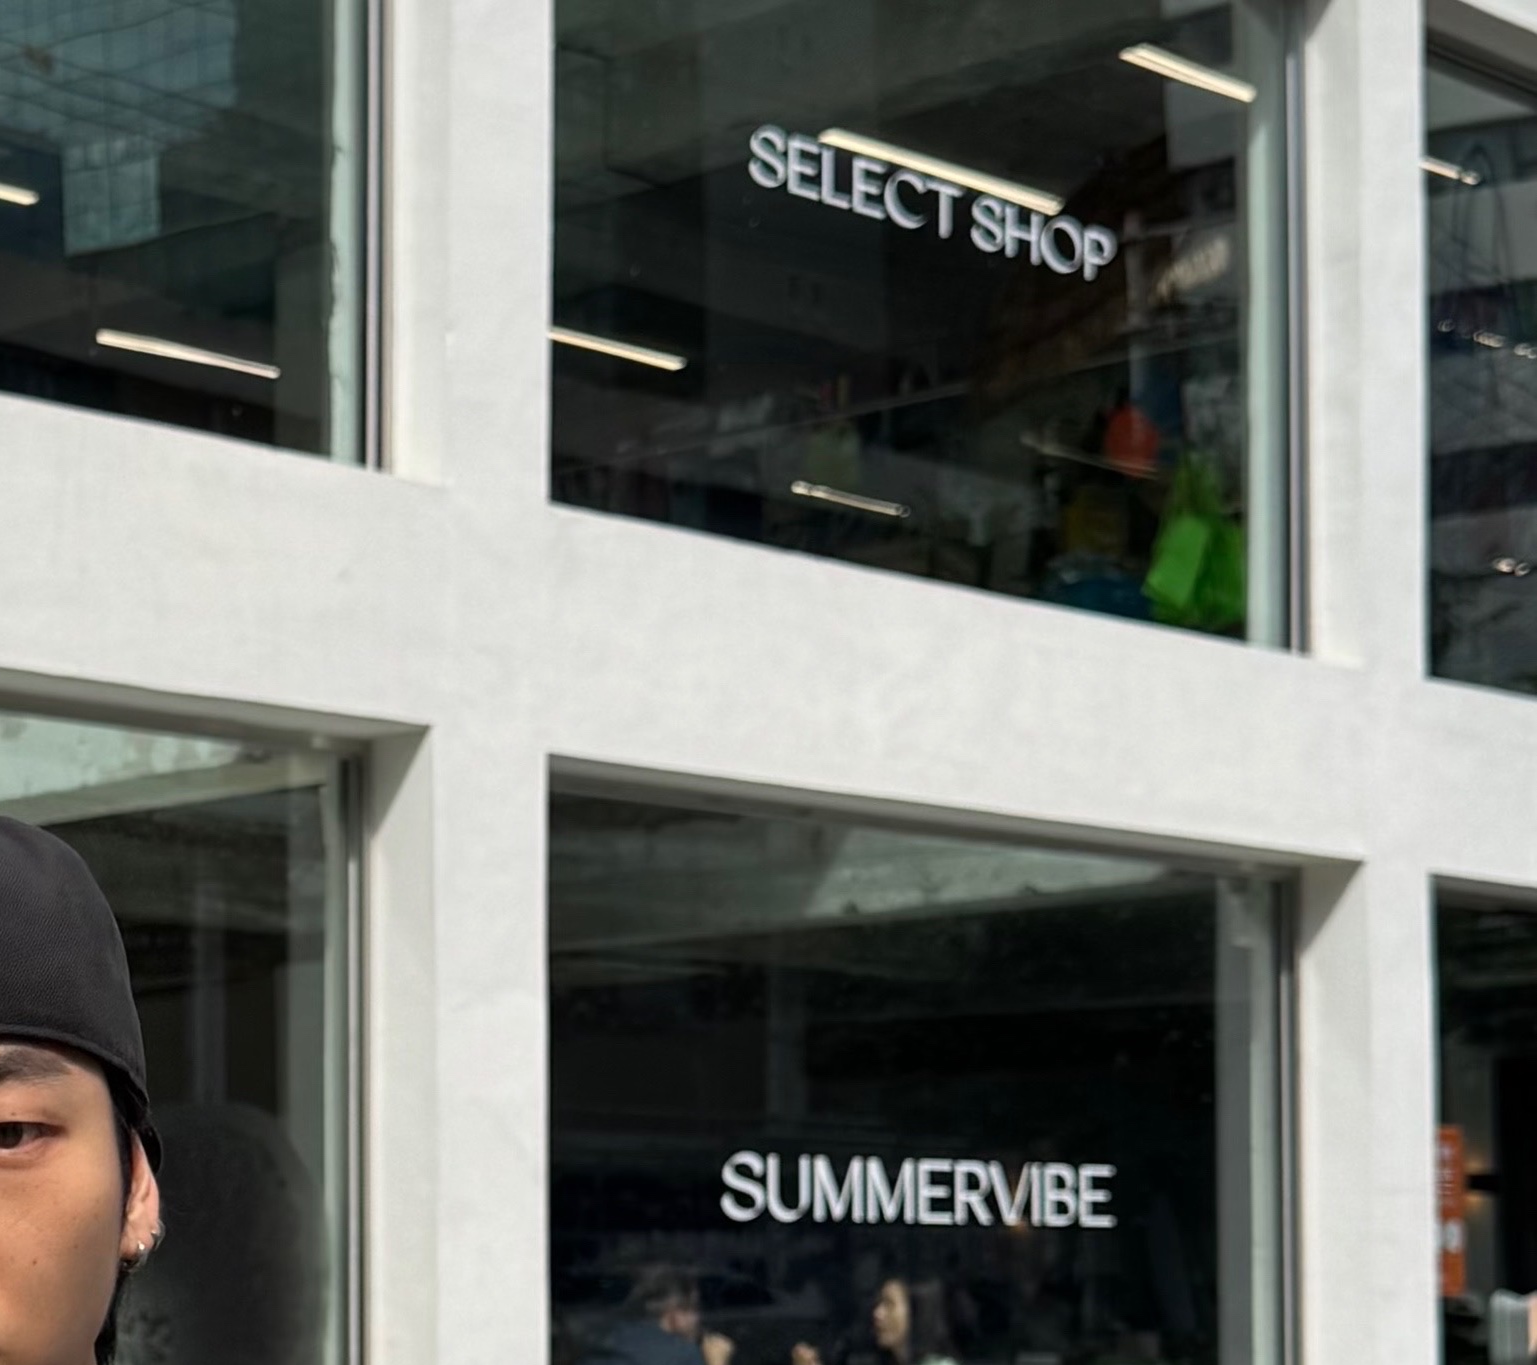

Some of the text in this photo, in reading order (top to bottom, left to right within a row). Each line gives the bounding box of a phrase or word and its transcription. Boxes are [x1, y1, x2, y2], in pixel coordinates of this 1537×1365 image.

[748, 124, 1119, 282] SELECT SHOP
[720, 1149, 1117, 1228] SUMMERVIBE
